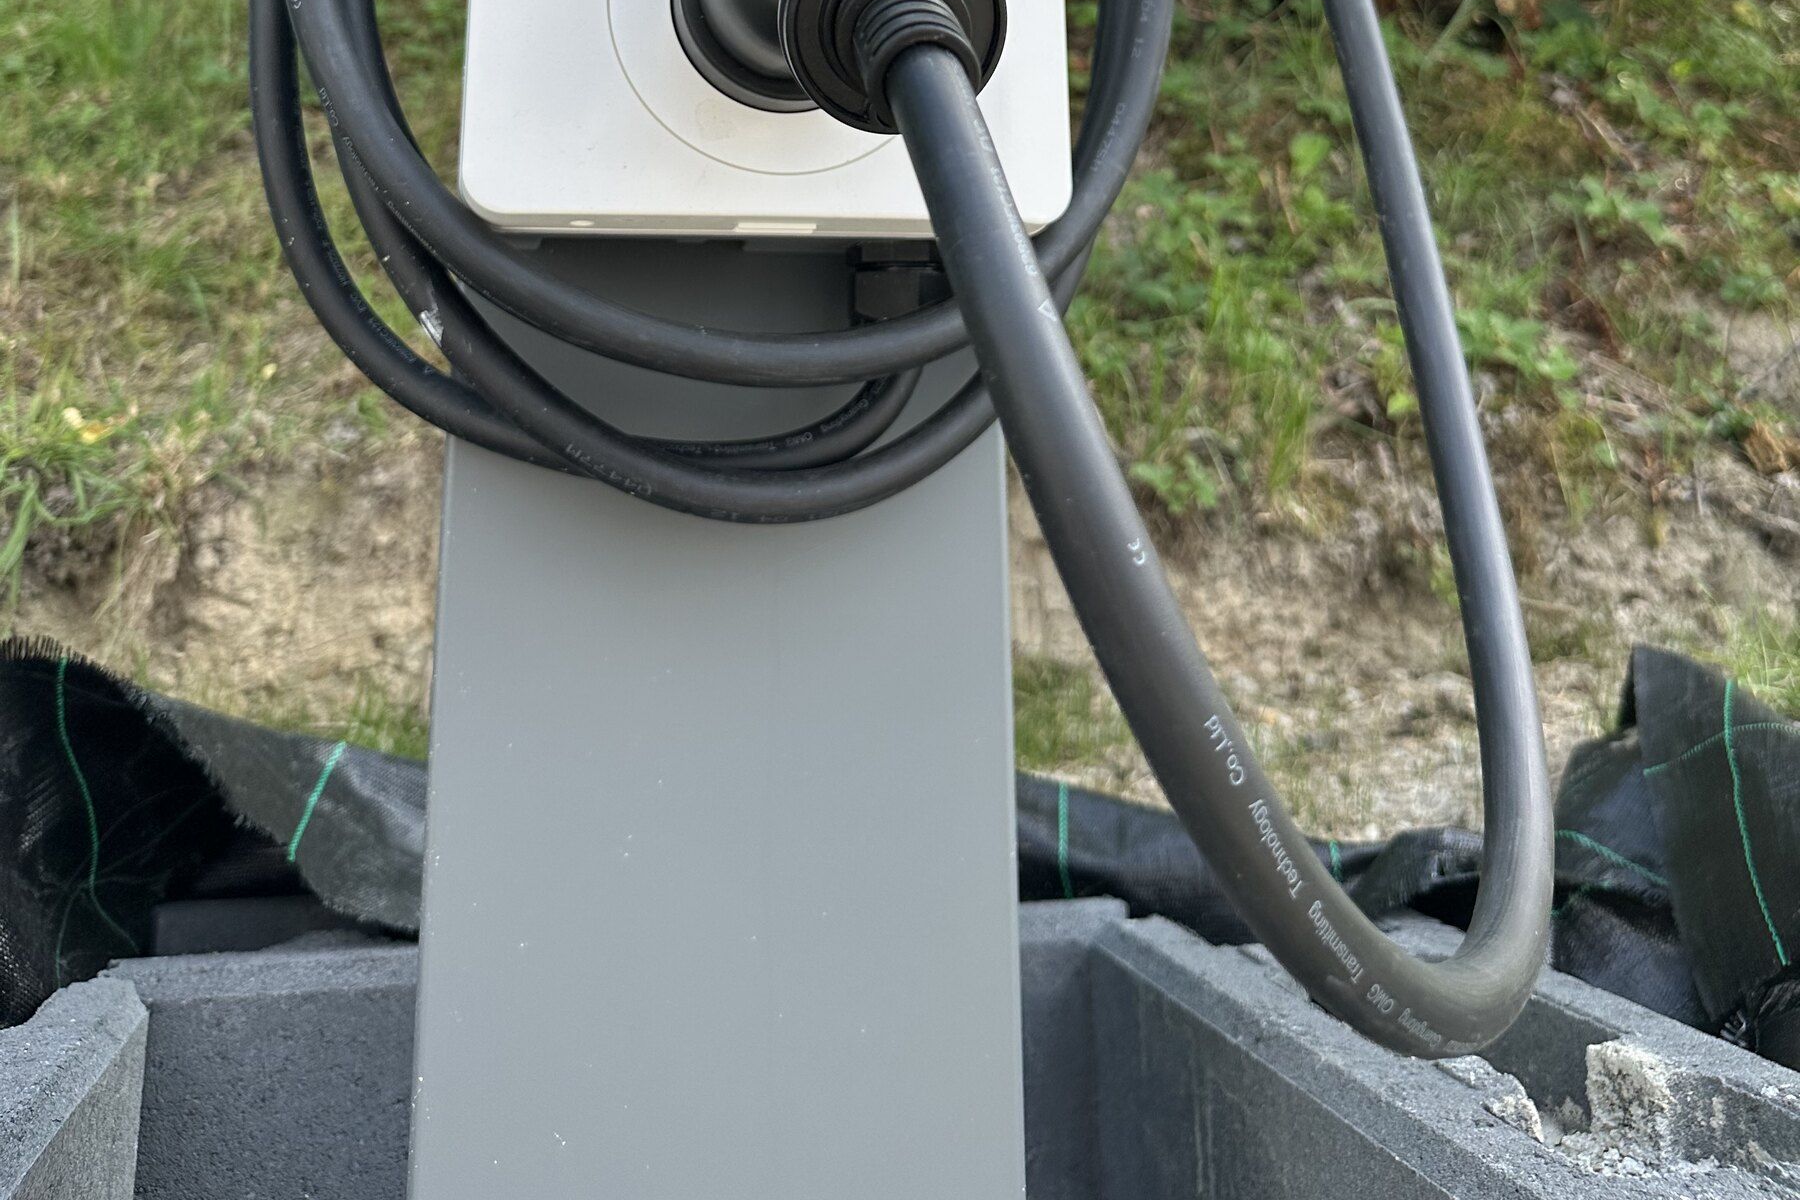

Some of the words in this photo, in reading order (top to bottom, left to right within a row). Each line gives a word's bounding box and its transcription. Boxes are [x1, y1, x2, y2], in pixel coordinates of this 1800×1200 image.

[1247, 799, 1305, 899] Technology
[1307, 898, 1364, 984] Transmitting
[1366, 983, 1395, 1014] OMG
[1397, 1006, 1443, 1048] Guangdong
